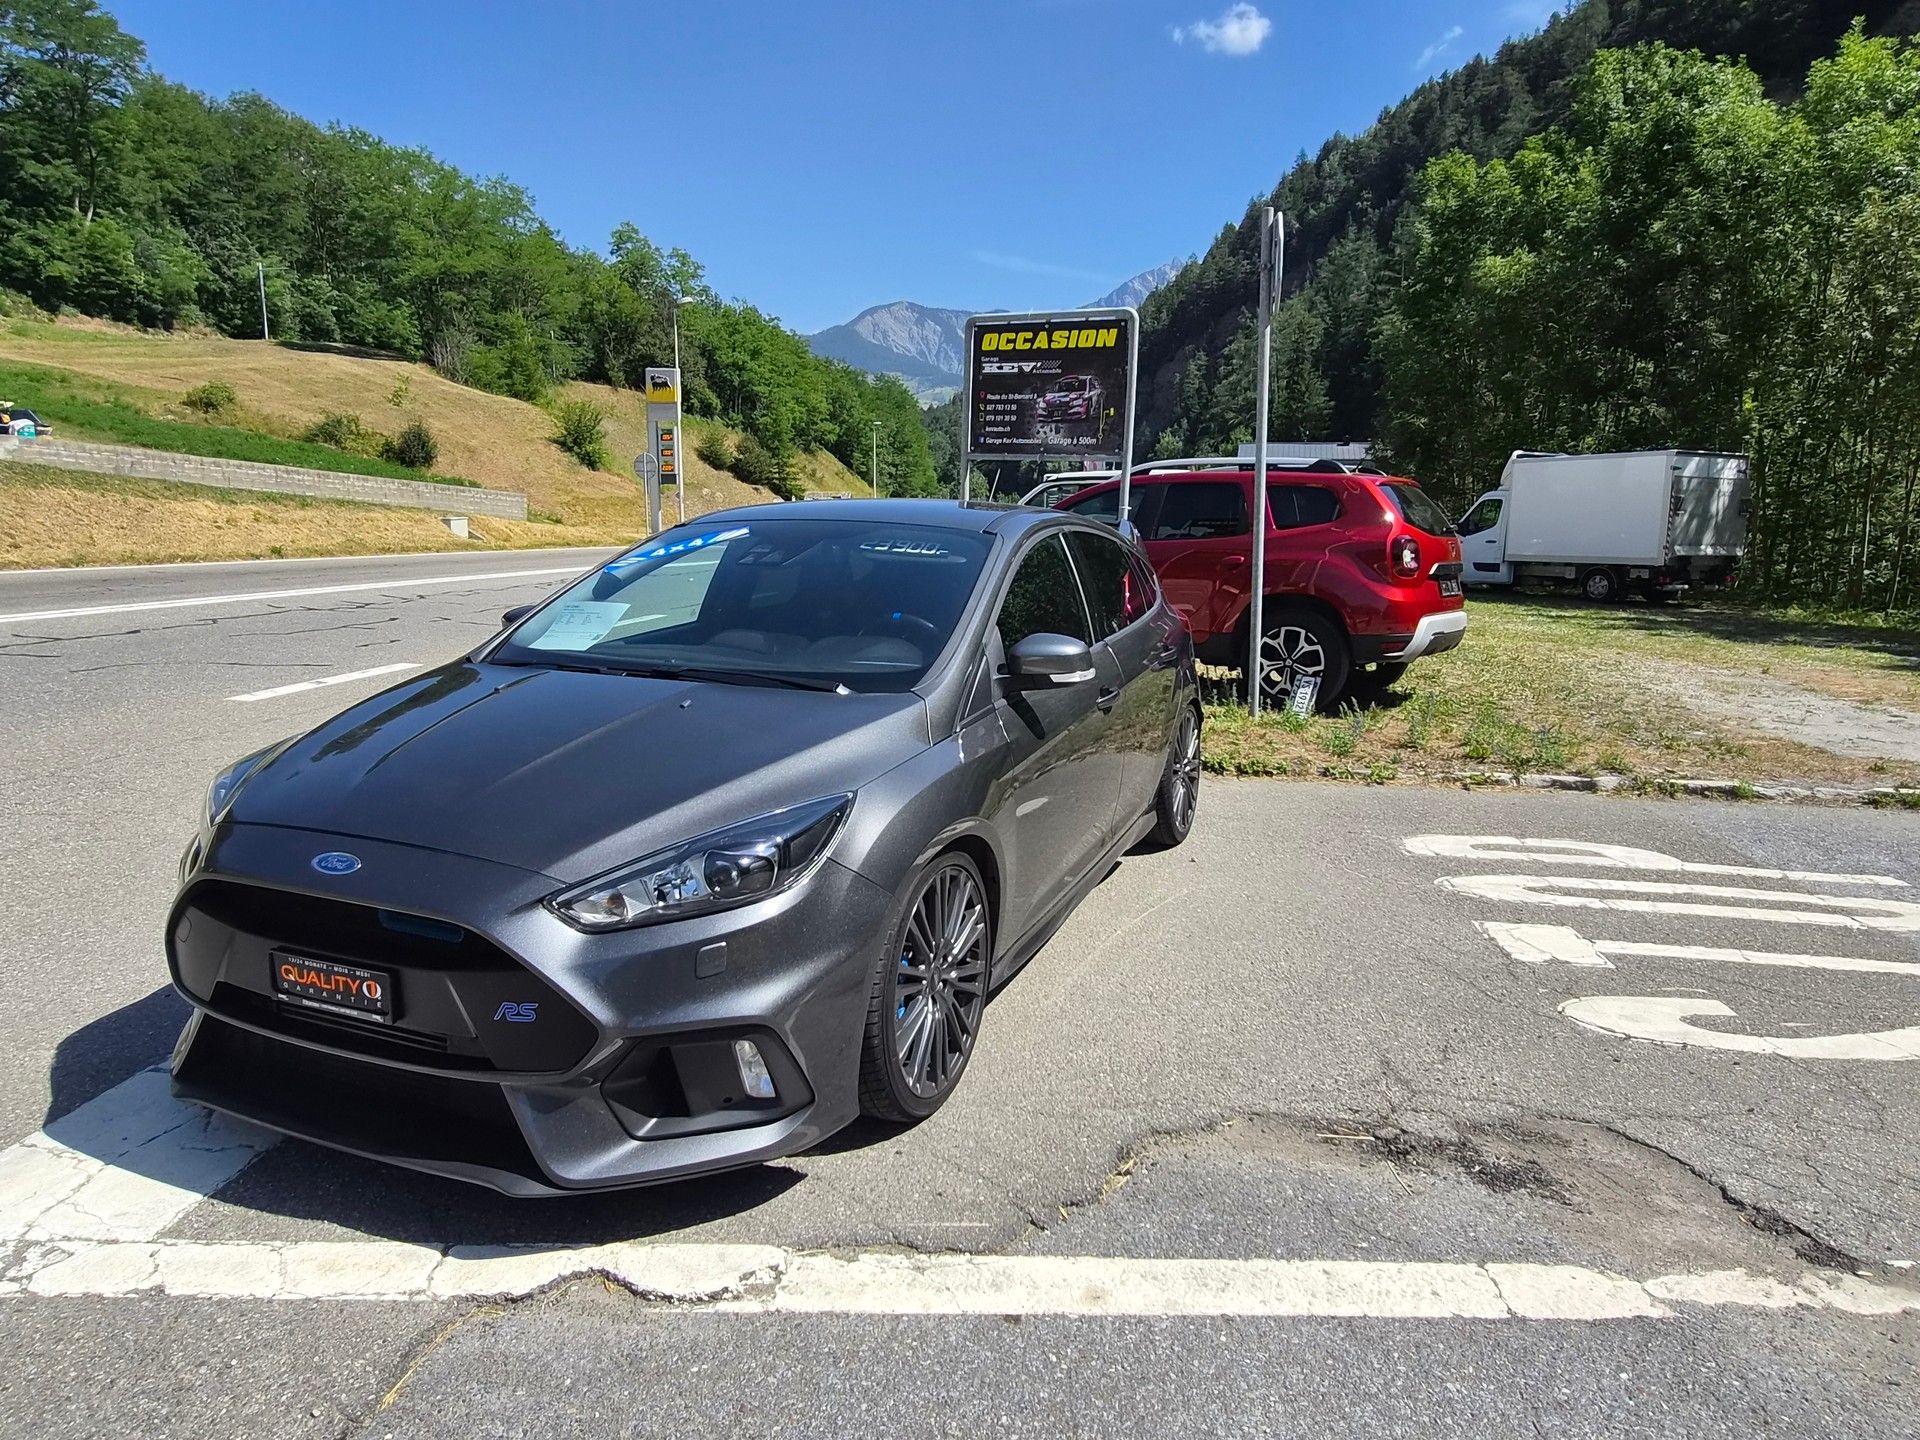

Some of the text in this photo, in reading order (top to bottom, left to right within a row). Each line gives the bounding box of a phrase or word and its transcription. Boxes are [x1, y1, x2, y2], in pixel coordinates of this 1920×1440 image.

[981, 328, 1118, 351] OCCASION
[1048, 436, 1071, 446] Garage
[1078, 436, 1097, 445] 500m
[1301, 680, 1313, 690] VS
[281, 964, 361, 995] QUALITY
[283, 981, 382, 1008] GARANTIE
[494, 1001, 539, 1022] RS
